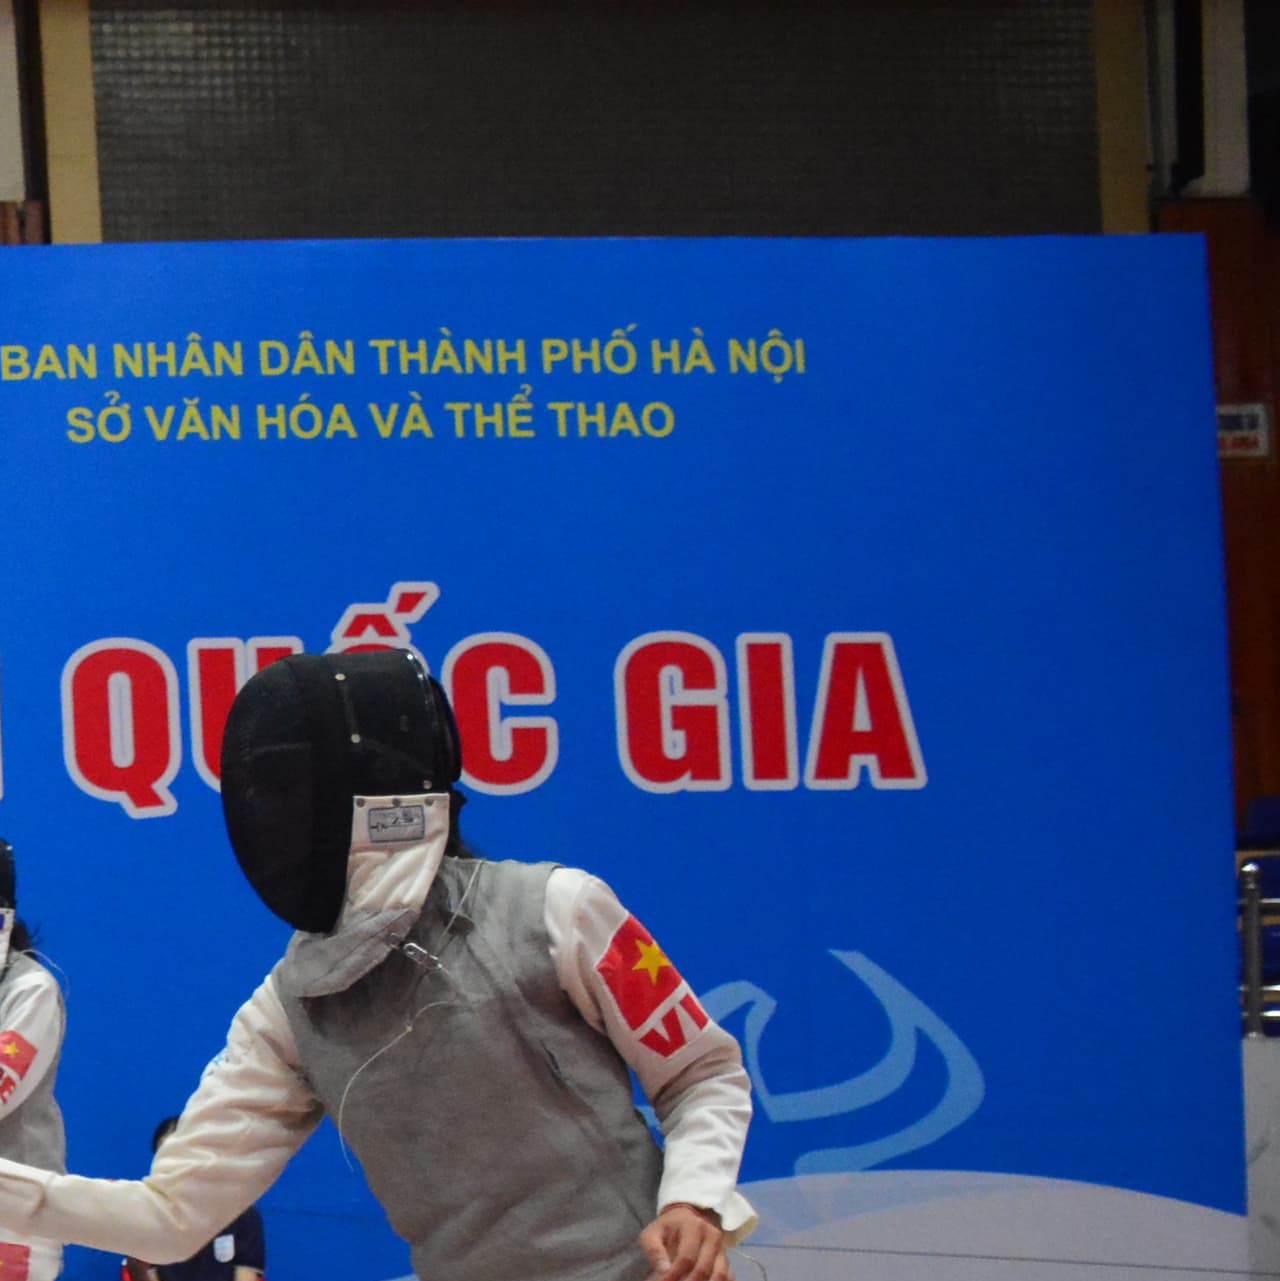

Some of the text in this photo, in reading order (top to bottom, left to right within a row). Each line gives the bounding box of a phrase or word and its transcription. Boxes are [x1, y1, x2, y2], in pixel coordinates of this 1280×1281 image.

[0, 343, 97, 381] BAN
[113, 332, 243, 378] NHÂN
[260, 330, 355, 376] DÂN
[368, 326, 526, 375] THÀNH
[542, 323, 638, 375] PHỐ
[651, 326, 716, 375] HÀ
[729, 328, 806, 384] NỘI
[66, 383, 675, 443] SỞ VĂN HÓA VÀ THỂ THAO
[60, 581, 559, 820] QC
[615, 630, 928, 799] GIA
[638, 992, 709, 1058] VI
